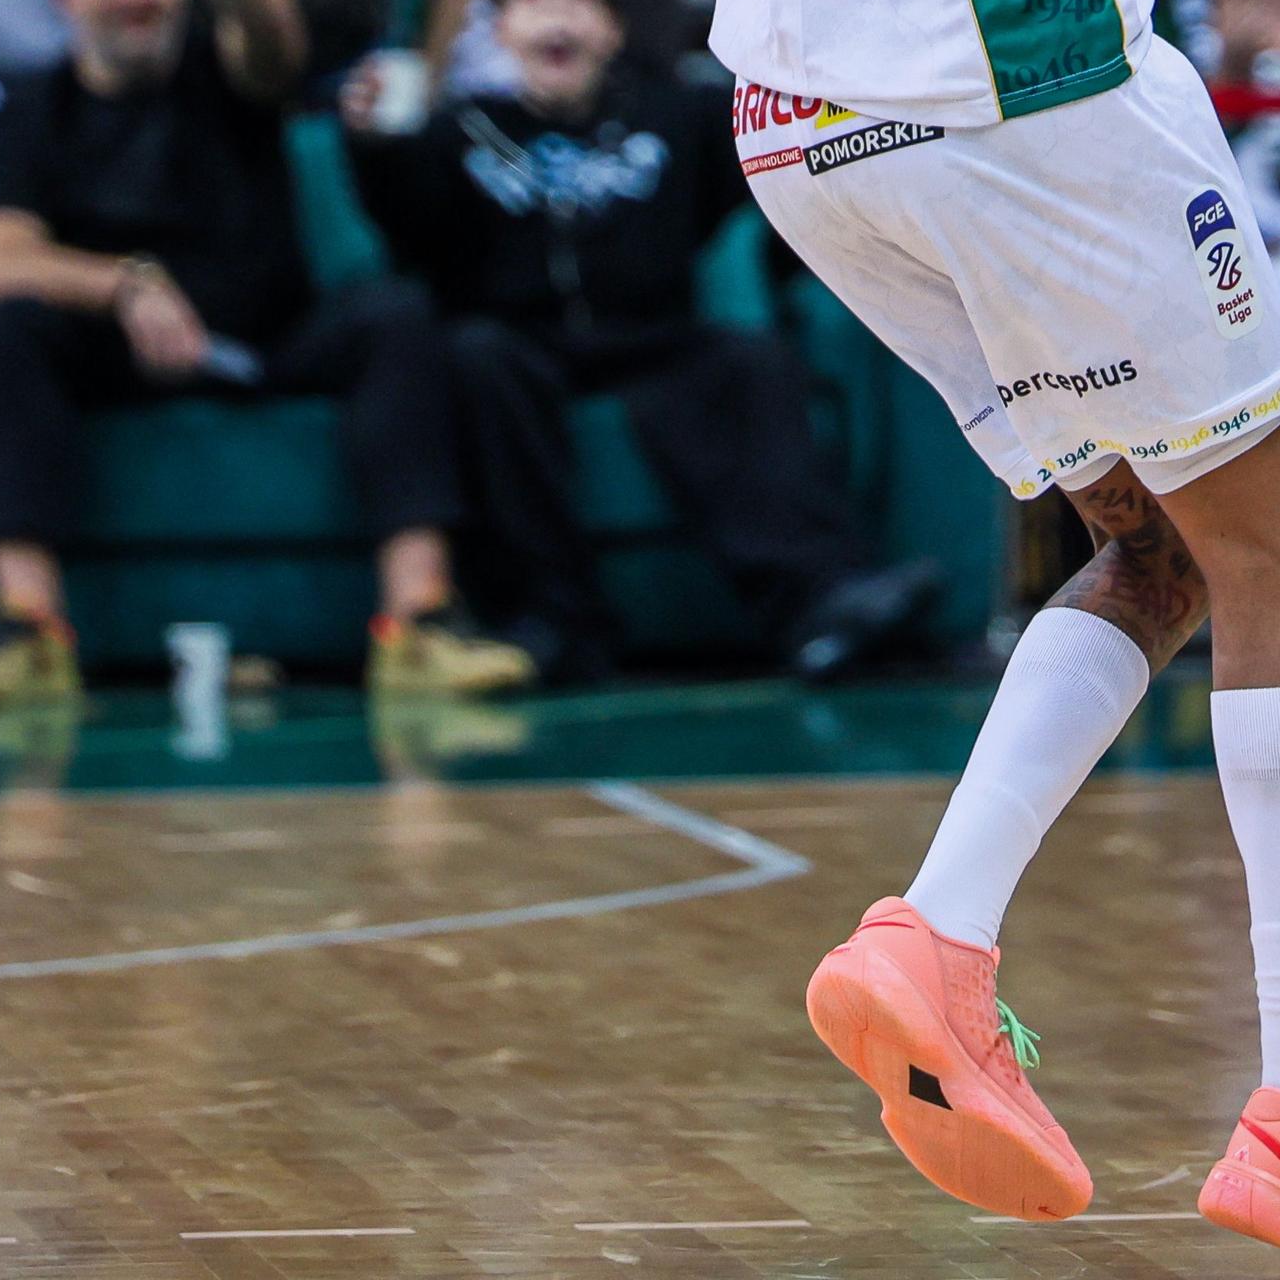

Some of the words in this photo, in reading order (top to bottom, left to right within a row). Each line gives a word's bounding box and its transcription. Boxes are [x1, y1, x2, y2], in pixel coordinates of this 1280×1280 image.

[1000, 42, 1089, 96] 1946
[1194, 200, 1226, 232] PGE
[1217, 288, 1255, 316] Basket
[1228, 306, 1253, 325] Liga
[996, 359, 1138, 408] perceptus
[1056, 438, 1096, 468] 1946
[1131, 439, 1168, 459] 1946
[1171, 426, 1210, 450] 1946
[1212, 407, 1250, 436] 1946
